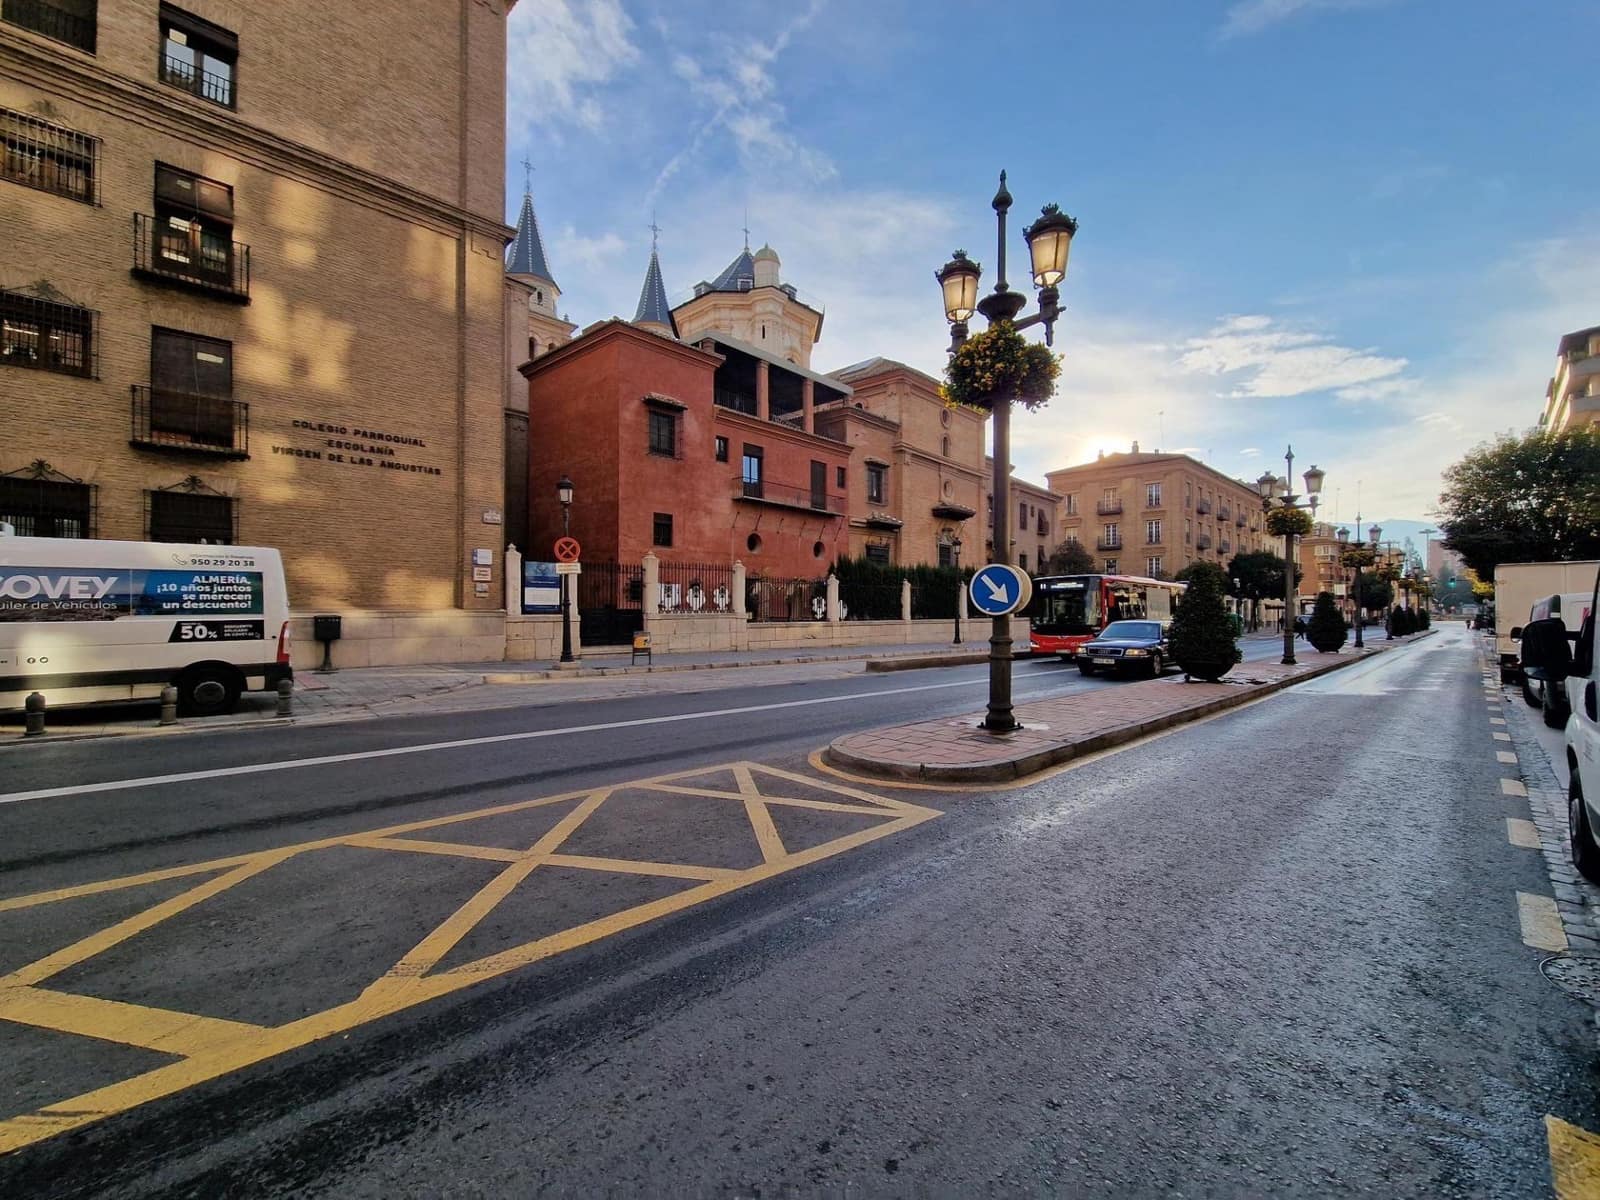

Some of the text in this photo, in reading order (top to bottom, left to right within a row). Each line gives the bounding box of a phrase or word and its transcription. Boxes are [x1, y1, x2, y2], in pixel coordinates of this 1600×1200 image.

[292, 420, 426, 448] COLEGIO PARROQUIAL
[327, 439, 395, 456] ESCOLANÍA
[272, 445, 441, 475] VIRGEN DE LAS ANGUSTIAS
[191, 558, 210, 566] 950
[157, 583, 252, 593] ¡10 años juntos
[182, 593, 252, 601] se merecen
[31, 600, 49, 610] de
[53, 600, 118, 610] Vehículos
[162, 601, 252, 609] un descuento!
